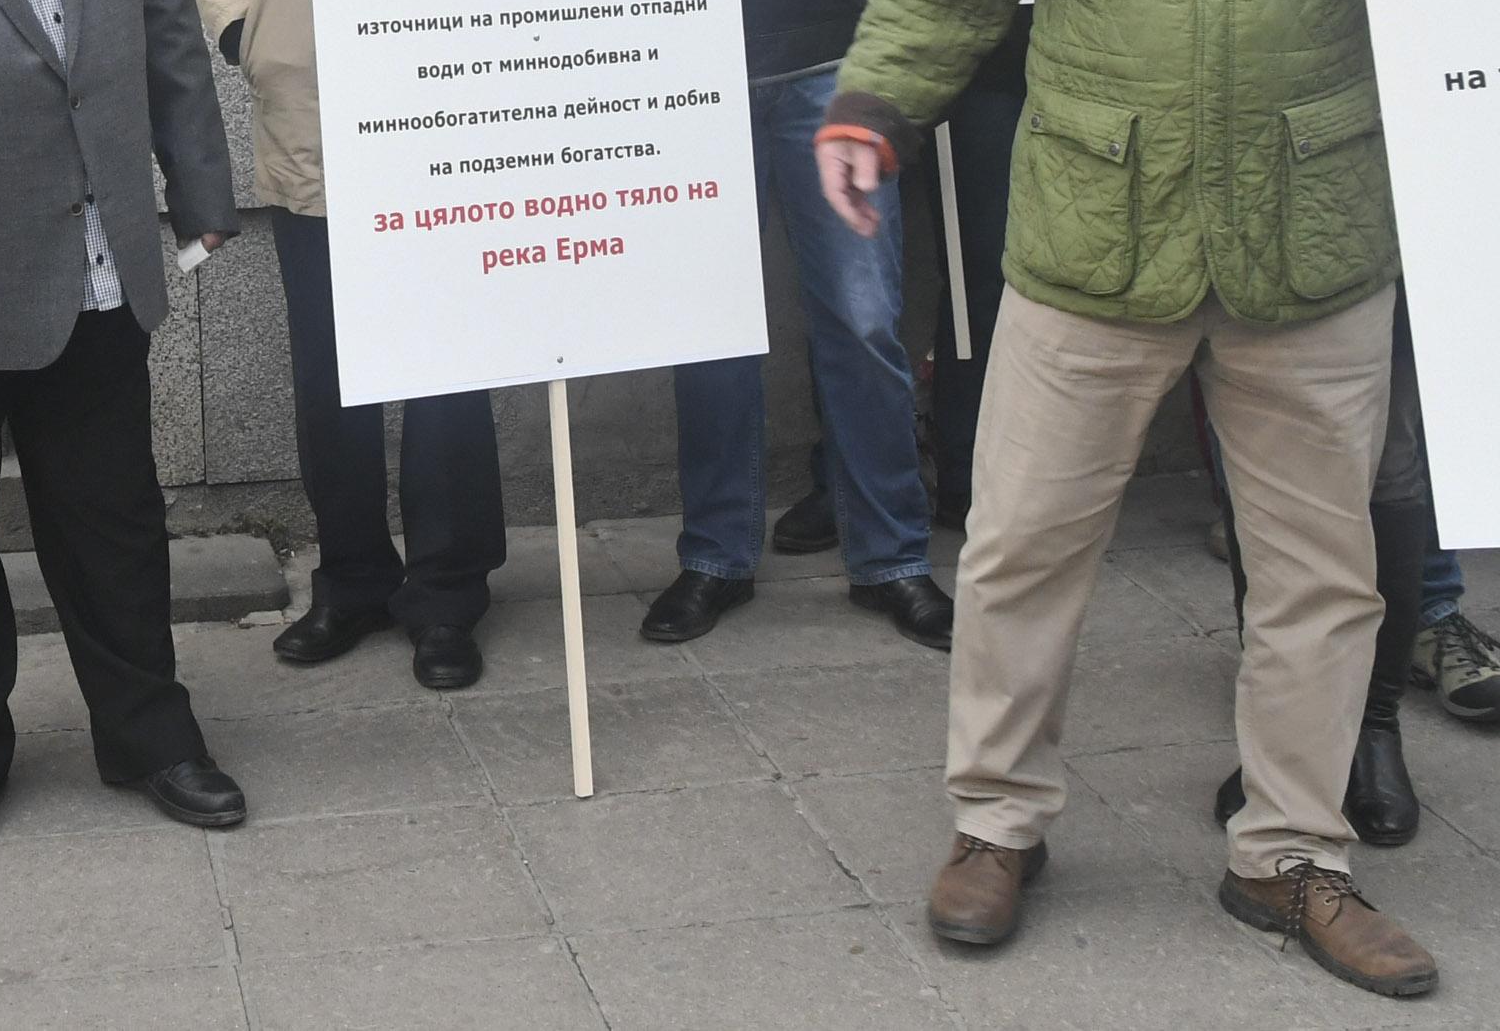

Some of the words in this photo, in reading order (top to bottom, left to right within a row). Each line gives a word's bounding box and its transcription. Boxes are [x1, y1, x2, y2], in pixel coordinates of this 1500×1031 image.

[356, 15, 464, 36] източници
[469, 13, 494, 28] на
[499, 3, 625, 30] промишлени
[417, 62, 465, 81] води
[470, 60, 494, 76] от
[498, 48, 642, 74] миннодобивна
[647, 47, 660, 62] и
[1443, 69, 1487, 92] на
[357, 104, 558, 135] миннообогатителна
[563, 96, 642, 121] дейност
[646, 96, 659, 110] и
[663, 88, 722, 112] добив
[429, 161, 454, 177] на
[458, 151, 555, 175] подземни
[560, 142, 662, 165] богатства.
[373, 211, 405, 233] за
[414, 200, 516, 232] цялото
[524, 191, 608, 219] водно
[614, 184, 679, 208] тяло
[687, 180, 719, 201] на
[481, 244, 547, 275] река
[555, 236, 625, 266] Ерма
